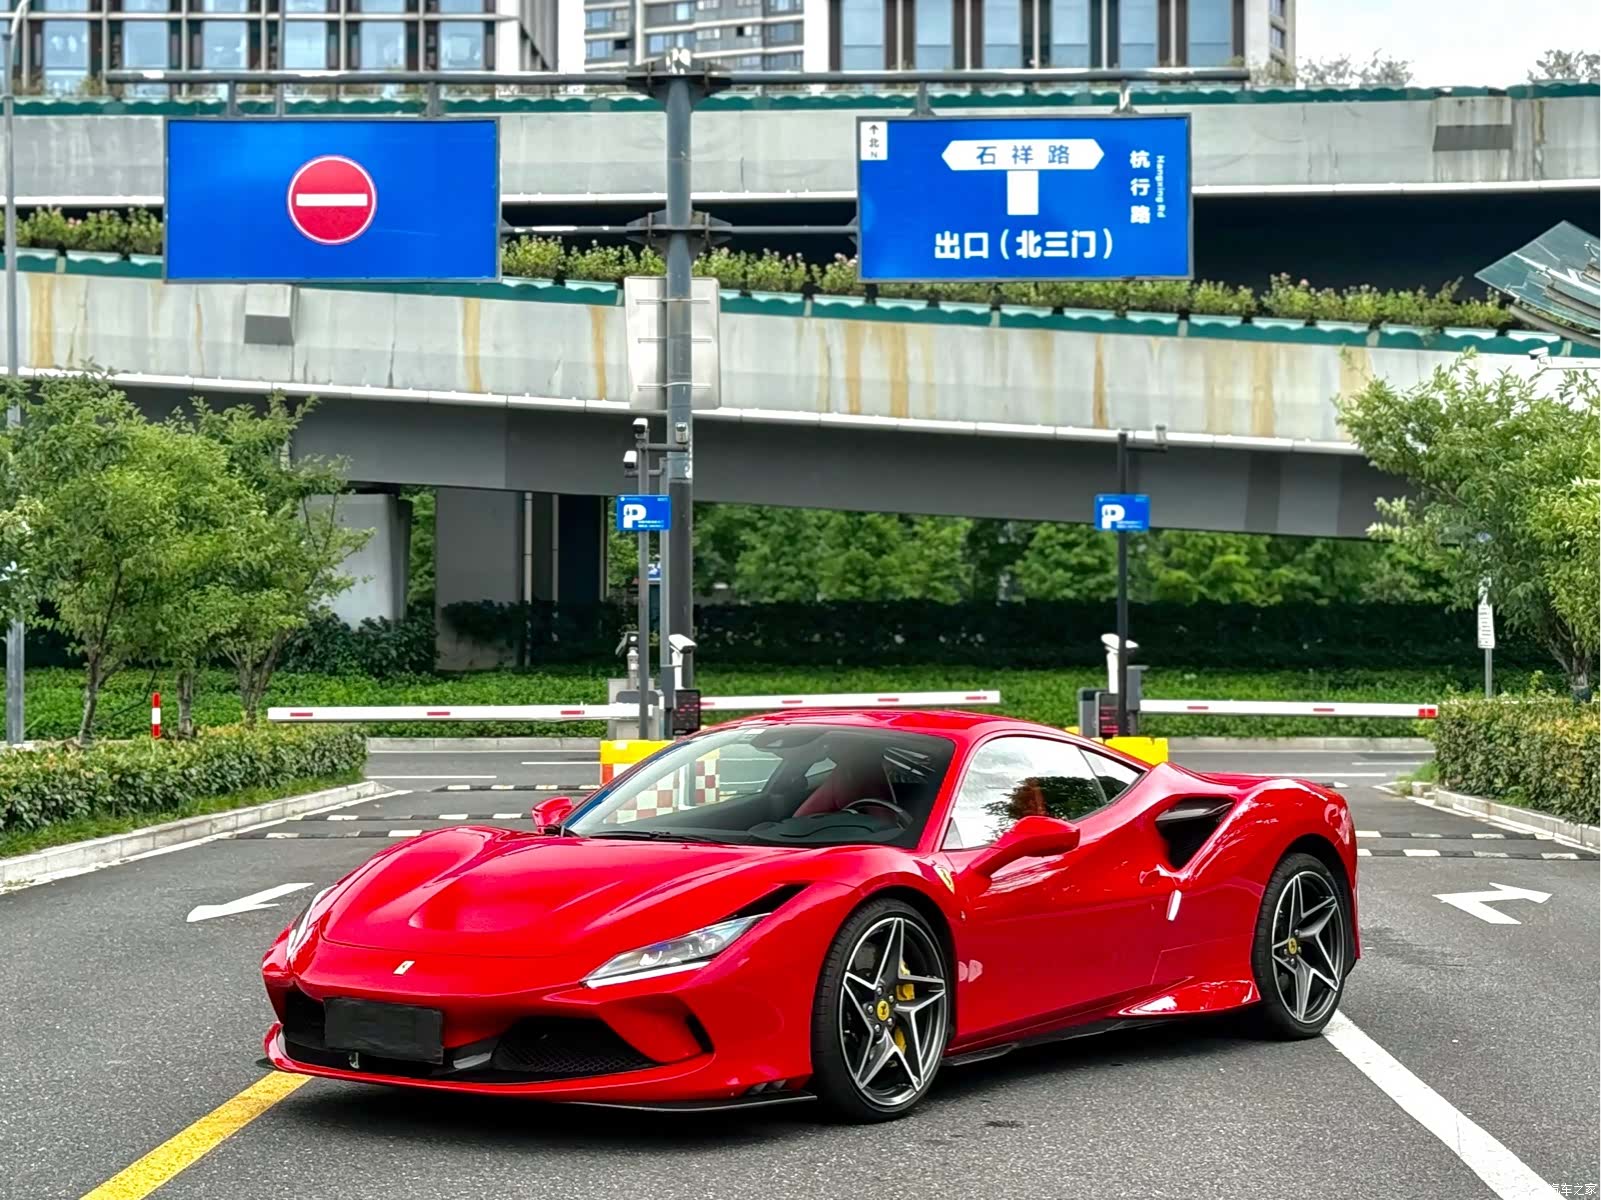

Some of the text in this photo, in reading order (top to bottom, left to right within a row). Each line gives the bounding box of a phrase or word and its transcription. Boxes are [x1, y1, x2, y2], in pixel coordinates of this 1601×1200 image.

[869, 137, 880, 148] 北
[976, 145, 1070, 165] 石祥路
[1130, 150, 1151, 224] 杭行路
[1155, 155, 1166, 218] Hangxing Rd
[623, 504, 647, 528] P
[1101, 504, 1125, 529] P
